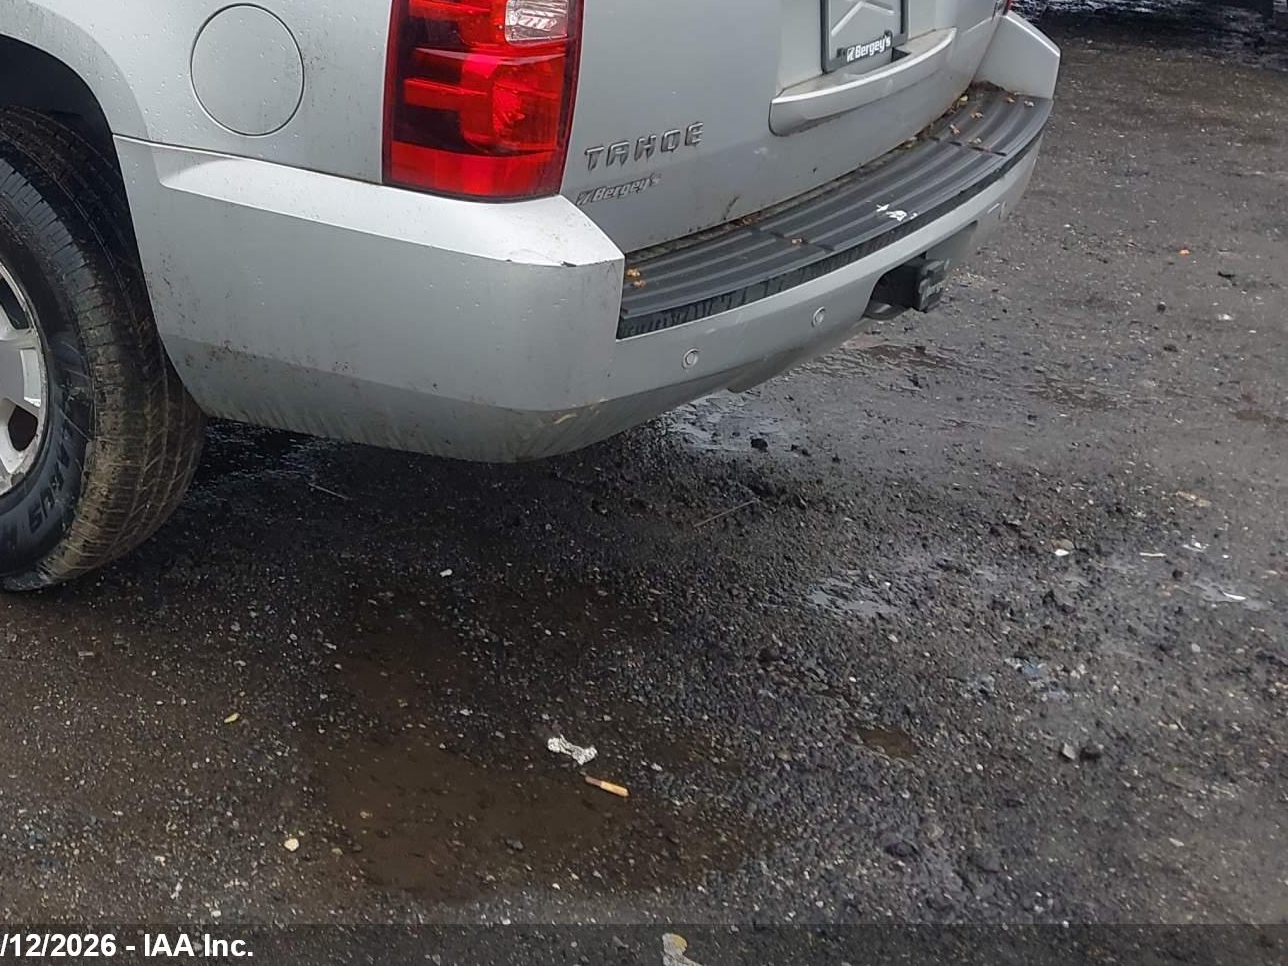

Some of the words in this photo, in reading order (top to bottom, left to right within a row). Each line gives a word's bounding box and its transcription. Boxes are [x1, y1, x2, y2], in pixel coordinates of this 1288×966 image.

[855, 35, 891, 58] Bergey's
[584, 121, 703, 171] TAHOE
[592, 173, 662, 203] Bergey's
